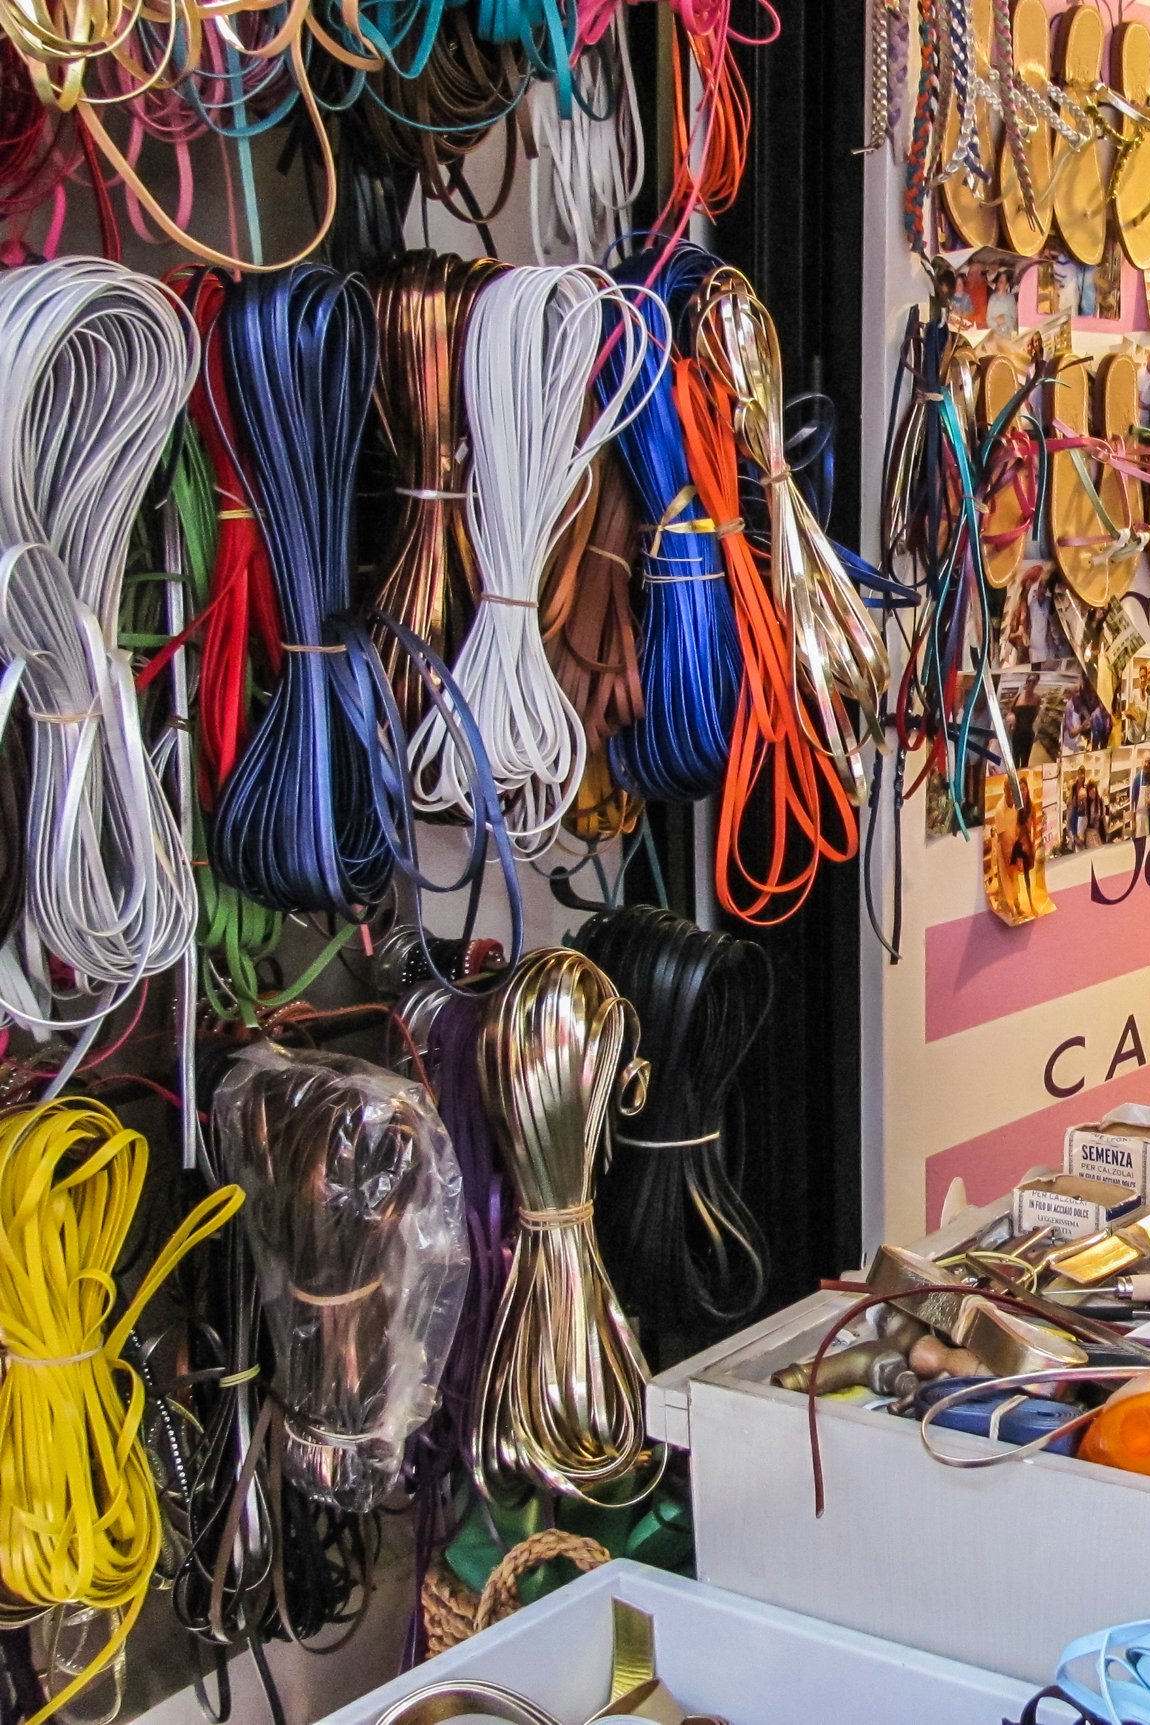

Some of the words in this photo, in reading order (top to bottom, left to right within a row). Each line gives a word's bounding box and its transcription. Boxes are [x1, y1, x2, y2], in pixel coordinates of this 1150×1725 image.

[1081, 1144, 1133, 1169] SEMENZA
[1081, 1163, 1096, 1171] PER
[1097, 1165, 1134, 1179] CALZOLAI
[1028, 1199, 1034, 1209] IN
[1035, 1200, 1046, 1211] FILO
[1053, 1204, 1073, 1216] ACCIAIO
[1073, 1207, 1089, 1219] DOLCE
